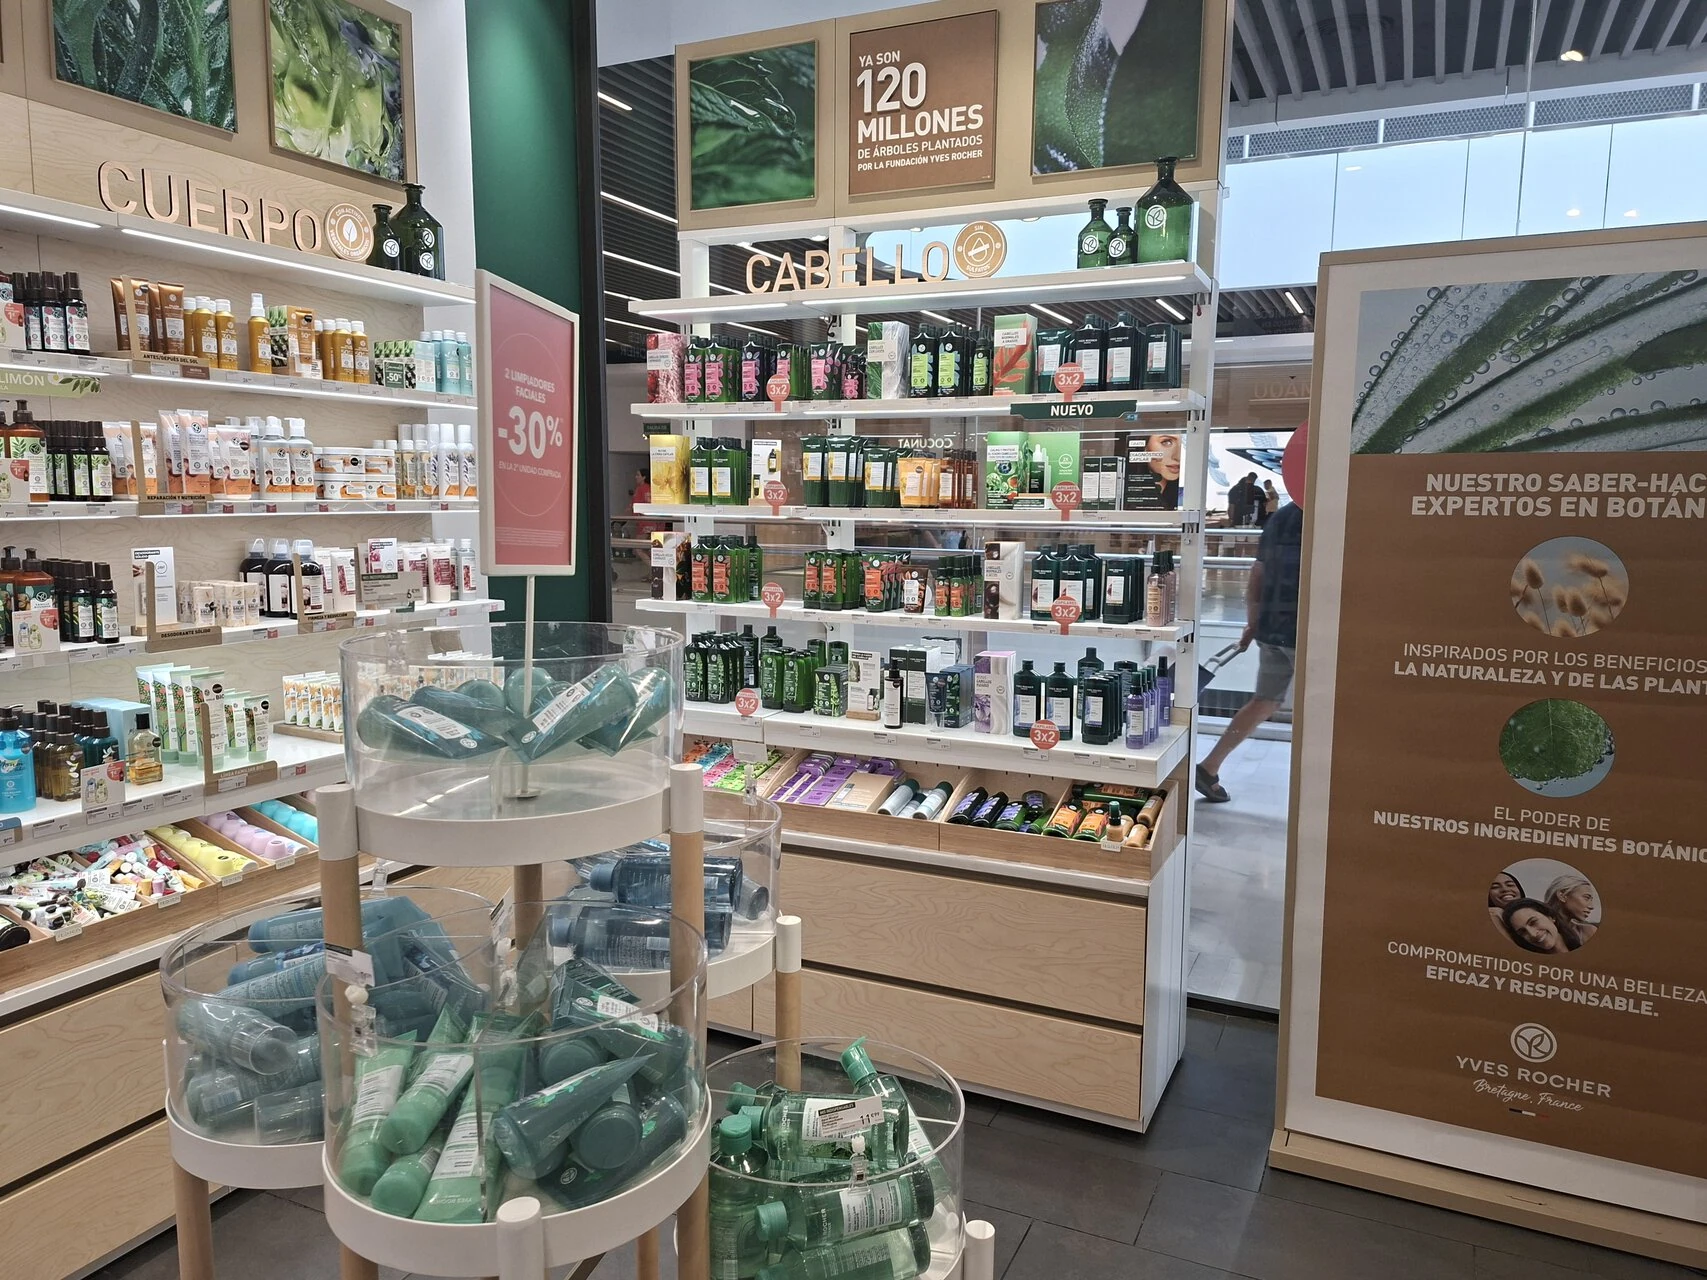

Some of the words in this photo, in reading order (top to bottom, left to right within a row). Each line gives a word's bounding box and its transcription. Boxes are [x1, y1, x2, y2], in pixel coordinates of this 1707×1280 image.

[859, 54, 873, 67] YA
[876, 50, 900, 65] SON
[856, 62, 927, 113] 120
[857, 104, 984, 144] MILLONES
[858, 148, 870, 159] DE
[873, 143, 919, 158] ÁRBOLES
[922, 134, 983, 152] PLANTADOS
[858, 161, 873, 172] POR
[874, 160, 884, 170] LA
[885, 154, 928, 169] FUNDACIÓN
[930, 153, 950, 164] YVES
[951, 149, 983, 161] ROCHER
[98, 160, 322, 252] CUERPO
[746, 241, 950, 295] CABELLO
[143, 353, 178, 363] ANTES/DEPUÉS
[0, 371, 45, 386] LIMÓN
[505, 368, 510, 379] 2
[510, 370, 555, 393] LIMPIADORES
[1058, 373, 1080, 386] 3x2
[515, 387, 546, 404] FACIALES
[769, 383, 788, 396] 3x2
[1050, 403, 1094, 417] NUEVO
[498, 405, 563, 459] -30%
[498, 460, 505, 470] EN
[505, 461, 513, 472] LA
[519, 463, 537, 476] UNIDAD
[1426, 473, 1542, 492] NUESTRO
[1547, 473, 1707, 493] SABER-HAC
[767, 489, 785, 501] 3x2
[1055, 491, 1077, 504] 3x2
[1411, 496, 1552, 517] EXPERTOS
[1559, 497, 1598, 517] EN
[1606, 491, 1706, 518] BOTÁN
[764, 591, 782, 603] 3x2
[1055, 605, 1077, 618] 3x2
[161, 629, 194, 638] DESODORANTE
[1404, 643, 1508, 662] INSPIRADOS
[1513, 649, 1549, 665] POR
[1554, 651, 1588, 667] LOS
[1593, 653, 1707, 674] BENEFICIOS
[1394, 661, 1417, 676] LA
[1422, 663, 1547, 685] NATURALEZA
[1550, 671, 1564, 686] Y
[1568, 671, 1594, 688] DE
[1599, 674, 1639, 691] LAS
[1644, 676, 1707, 695] PLANT
[738, 697, 756, 710] 3x2
[1033, 730, 1056, 743] 3x2
[1494, 806, 1515, 821] EL
[1520, 809, 1581, 829] PODER
[1586, 815, 1611, 831] DE
[1373, 811, 1469, 835] NUESTROS
[1473, 822, 1617, 853] INGREDIENTES
[1387, 941, 1533, 976] COMPROMETIDOS
[1538, 966, 1574, 983] POR
[1579, 971, 1618, 991] UNA
[1623, 977, 1707, 1004] BELLEZA
[1426, 965, 1489, 989] EFICAZ
[1494, 976, 1507, 991] Y
[1509, 978, 1659, 1017] RESPONSABLE.
[1456, 1055, 1509, 1078] YVES
[1517, 1067, 1611, 1098] ROCHER
[1537, 1092, 1584, 1112] France
